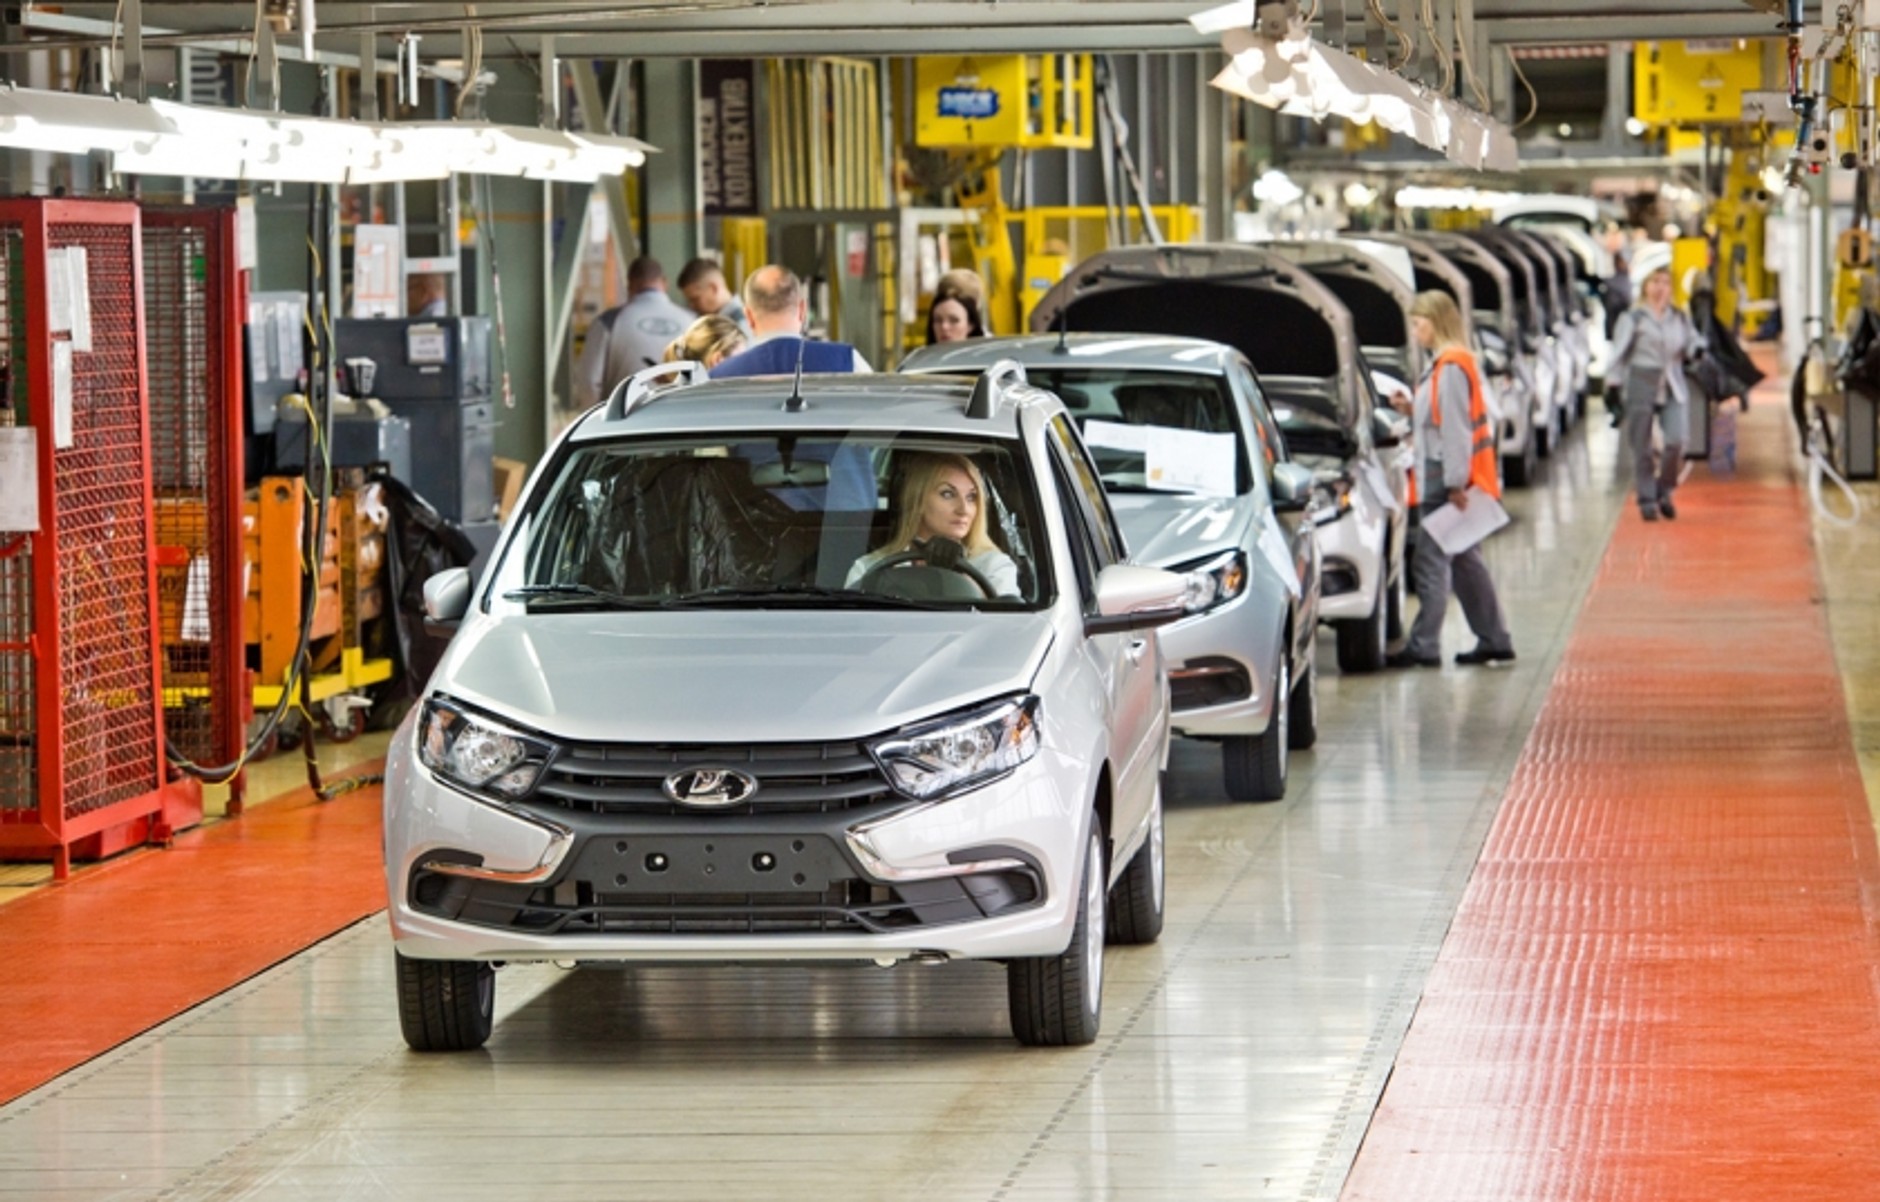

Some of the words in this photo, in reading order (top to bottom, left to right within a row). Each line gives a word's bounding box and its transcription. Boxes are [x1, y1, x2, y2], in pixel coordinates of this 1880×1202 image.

[1705, 93, 1717, 112] 2
[964, 123, 972, 140] 1
[720, 78, 751, 207] КОЛЛЕКТИВ
